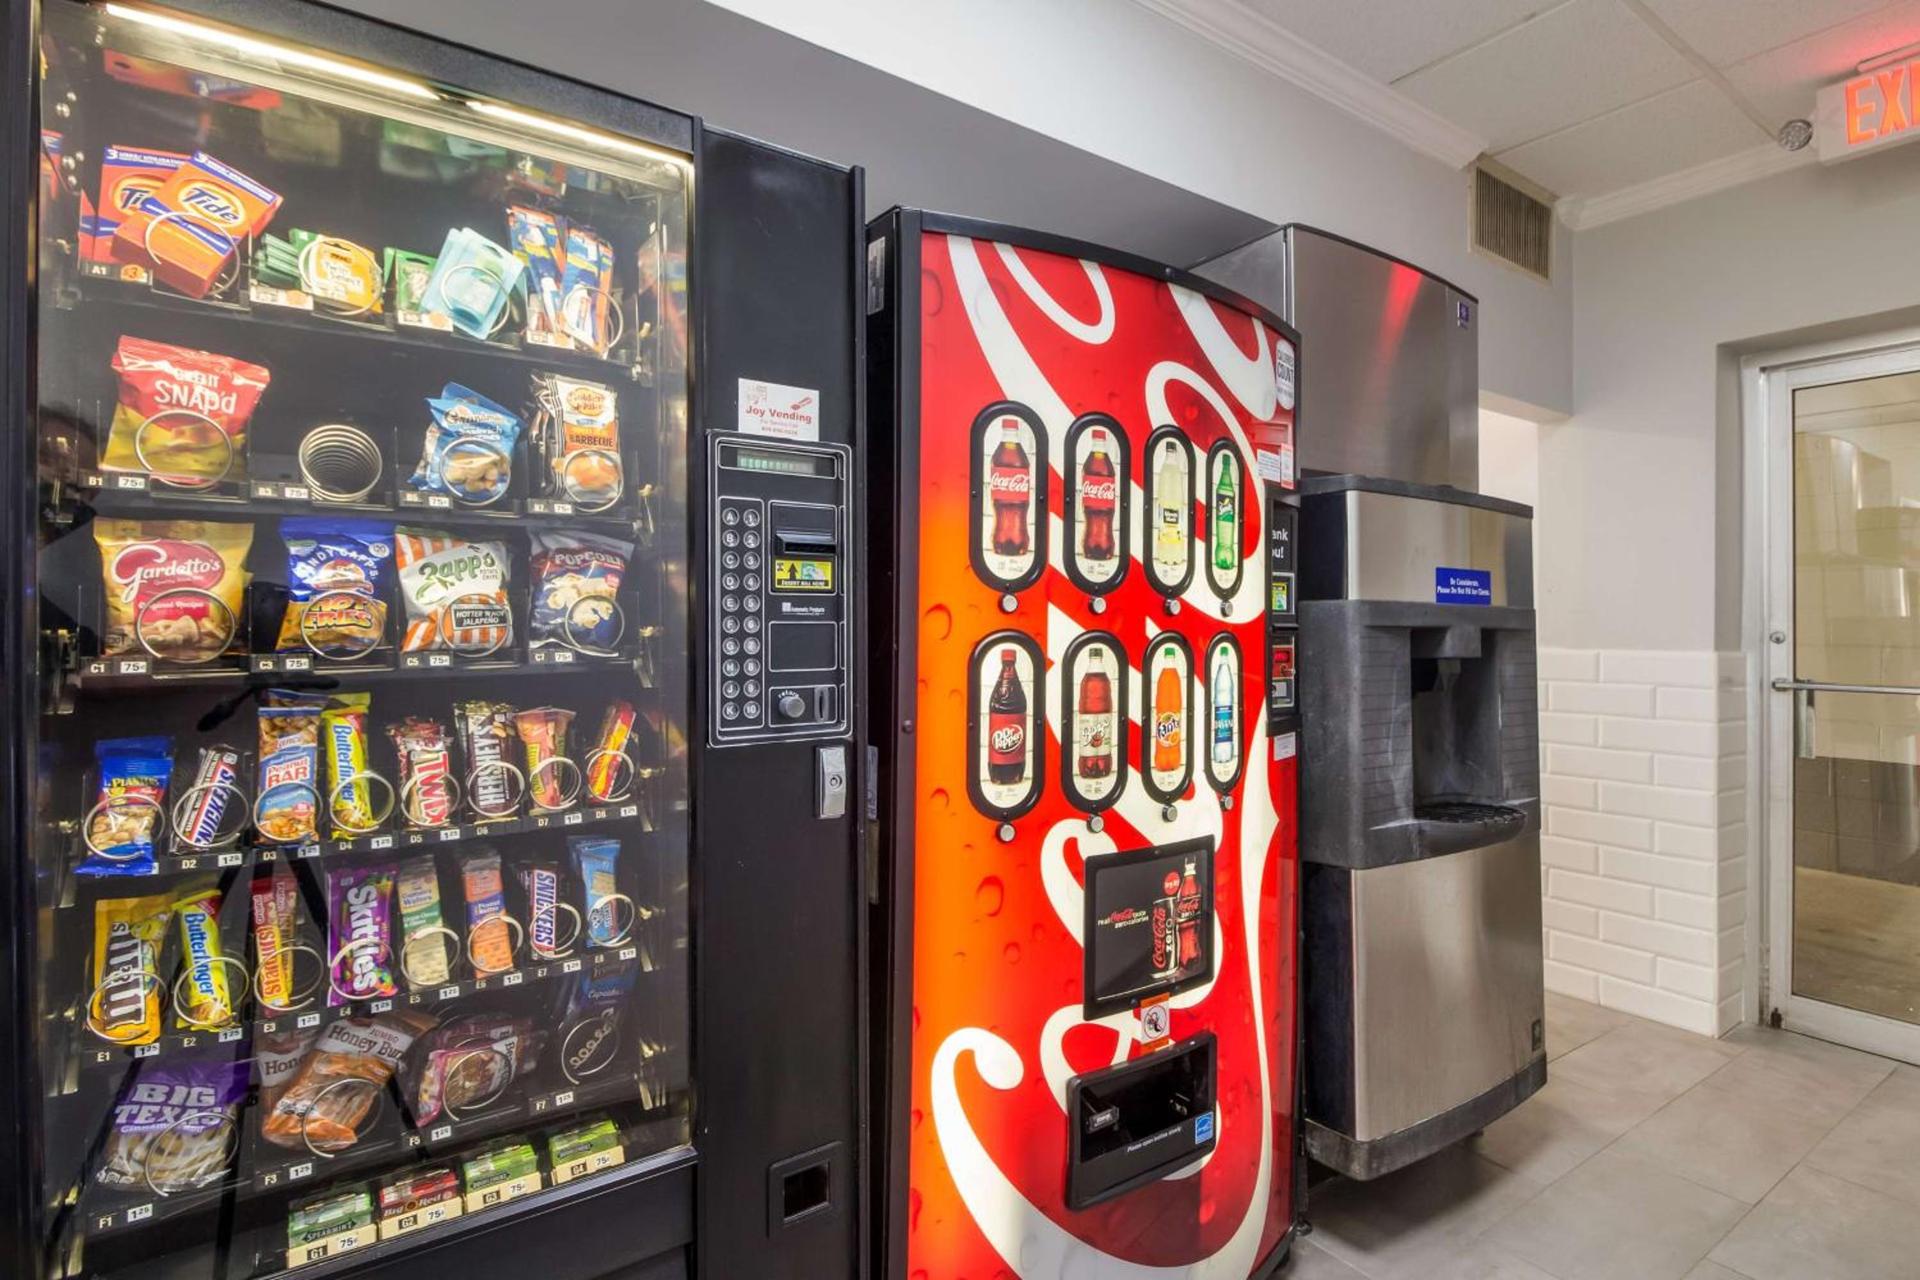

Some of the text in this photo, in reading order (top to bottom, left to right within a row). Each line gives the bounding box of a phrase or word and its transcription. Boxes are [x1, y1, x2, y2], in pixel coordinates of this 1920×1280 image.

[1845, 61, 1920, 144] EXI
[106, 149, 118, 160] 3
[120, 187, 150, 210] Ti
[182, 187, 240, 223] Tide
[92, 264, 107, 275] A1
[1278, 362, 1294, 383] COUNT
[746, 405, 766, 417] Joy
[769, 408, 812, 424] Vending
[88, 477, 103, 486] B1
[1272, 528, 1288, 541] ank
[112, 543, 221, 603] Gardetto's
[456, 609, 483, 619] HOTTER
[259, 661, 273, 669] C3
[407, 657, 419, 666] C5
[90, 663, 104, 673] C1
[778, 690, 800, 698] return
[994, 731, 1023, 750] Pepper
[473, 725, 505, 806] HERSHEY'S
[267, 767, 309, 788] BAR
[415, 751, 449, 824] TWIX
[538, 818, 549, 826] D7
[410, 835, 423, 843] D5
[339, 842, 352, 850] D4
[263, 851, 277, 860] D3
[182, 859, 197, 869] D2
[535, 871, 555, 946] SNICKERS
[348, 886, 380, 991] Skittles
[1165, 918, 1174, 952] zero
[184, 912, 214, 996] Butterfinger
[538, 968, 547, 976] E7
[184, 1037, 197, 1047] E2
[328, 1025, 378, 1053] Honey
[97, 1052, 111, 1062] E1
[265, 1057, 301, 1076] Hon
[132, 1083, 216, 1107] BIG
[114, 1105, 223, 1126] TEXAS
[409, 1137, 421, 1146] F5
[265, 1175, 277, 1185] F3
[100, 1217, 113, 1228] F1
[311, 1249, 323, 1259] G1
